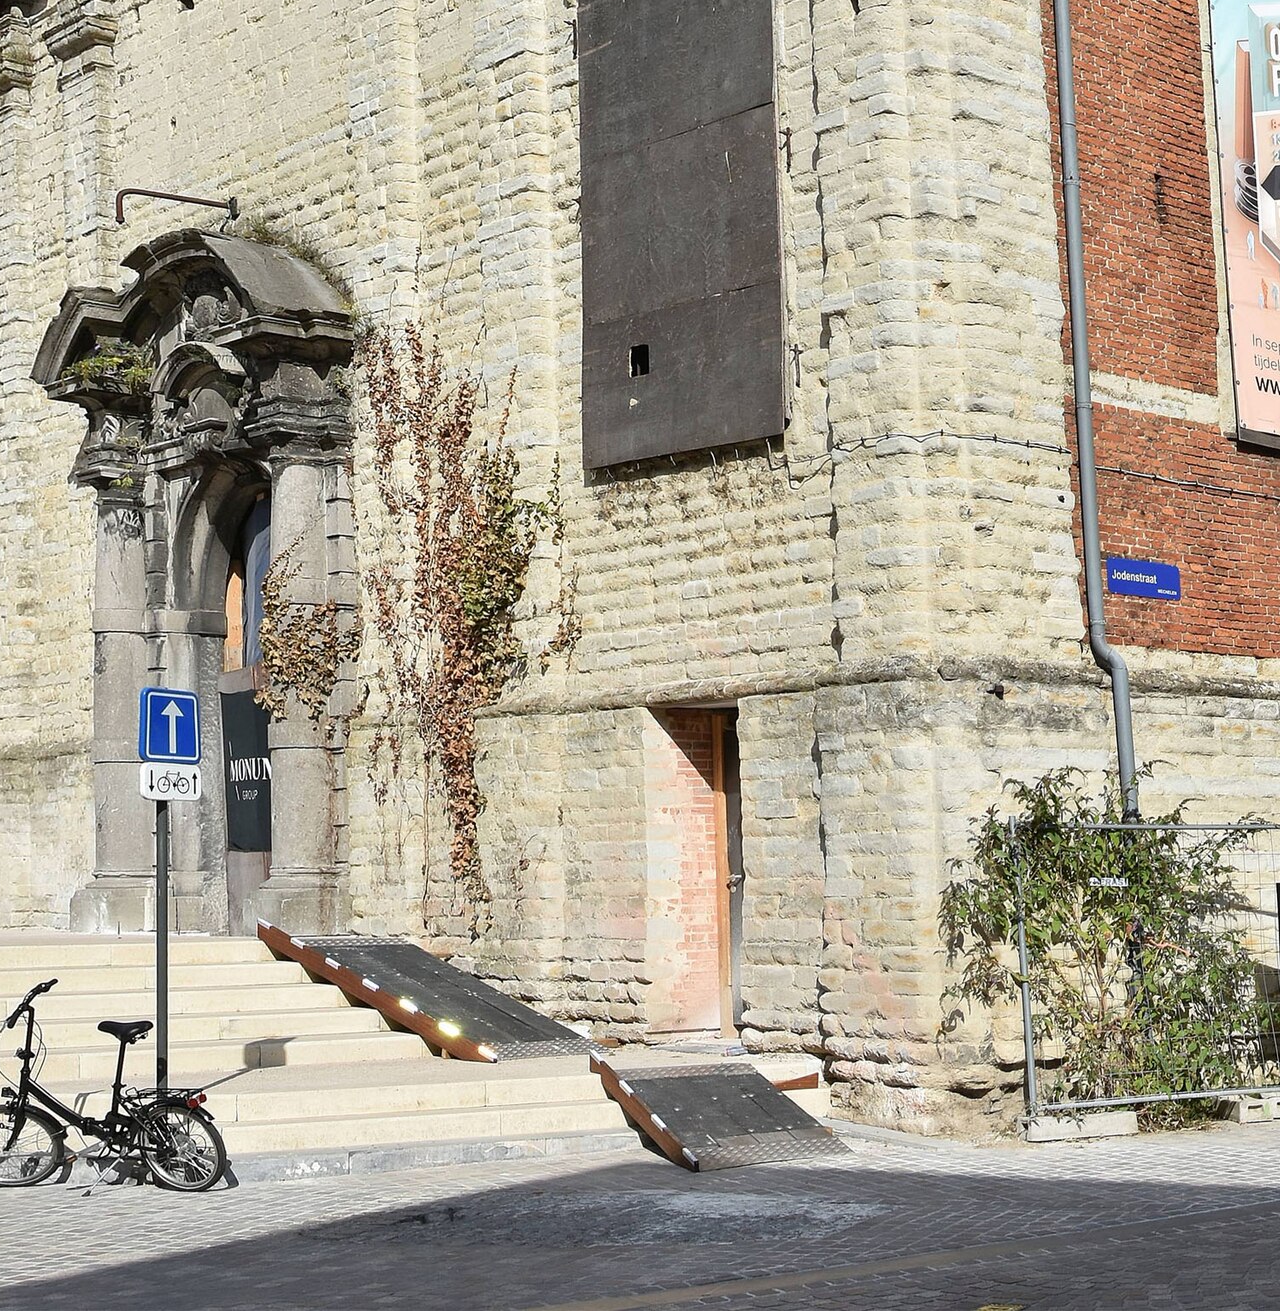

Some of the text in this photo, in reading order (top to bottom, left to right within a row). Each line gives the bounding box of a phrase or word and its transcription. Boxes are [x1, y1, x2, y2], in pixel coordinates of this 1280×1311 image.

[1252, 333, 1263, 348] In
[1111, 569, 1158, 585] Jodenstraat
[242, 789, 259, 800] GROUP
